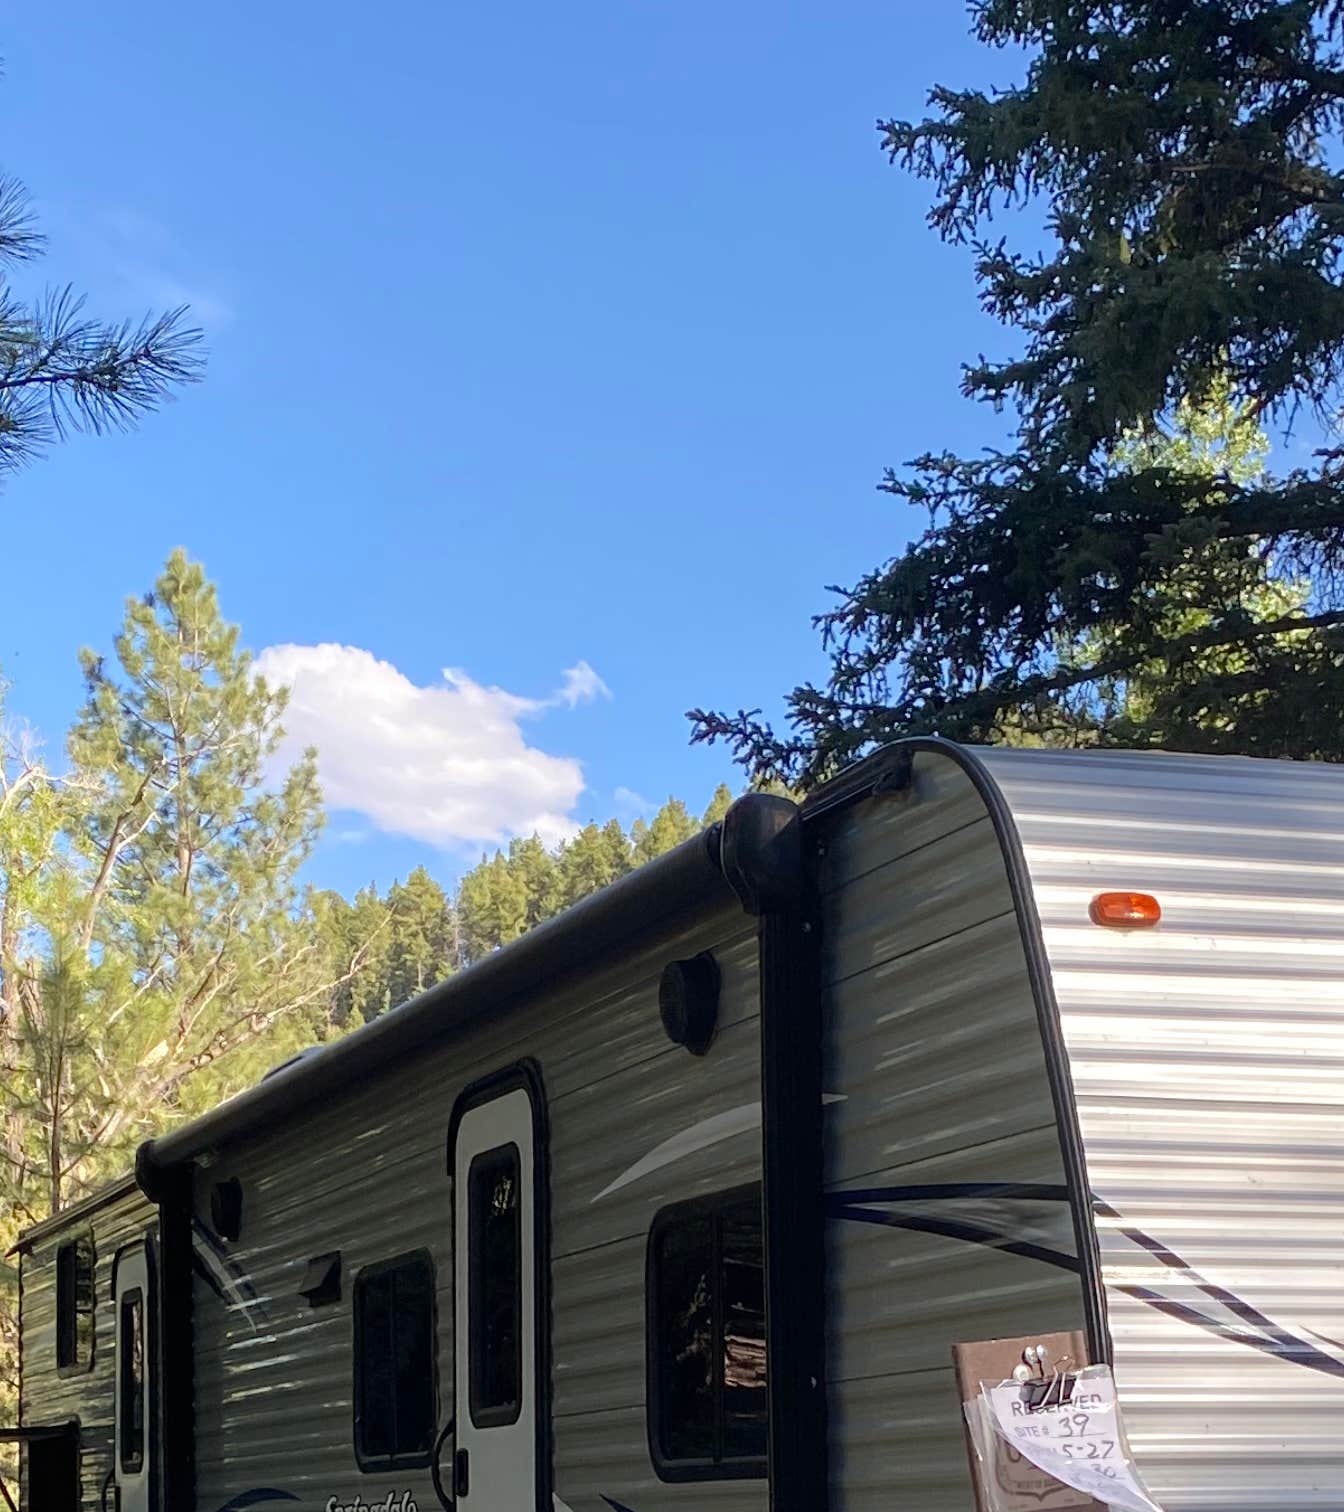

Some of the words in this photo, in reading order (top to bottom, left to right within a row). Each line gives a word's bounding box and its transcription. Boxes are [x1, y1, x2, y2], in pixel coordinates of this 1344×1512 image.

[1014, 1426, 1041, 1438] SITE
[1059, 1413, 1089, 1437] 39
[1062, 1440, 1115, 1460] 5-27
